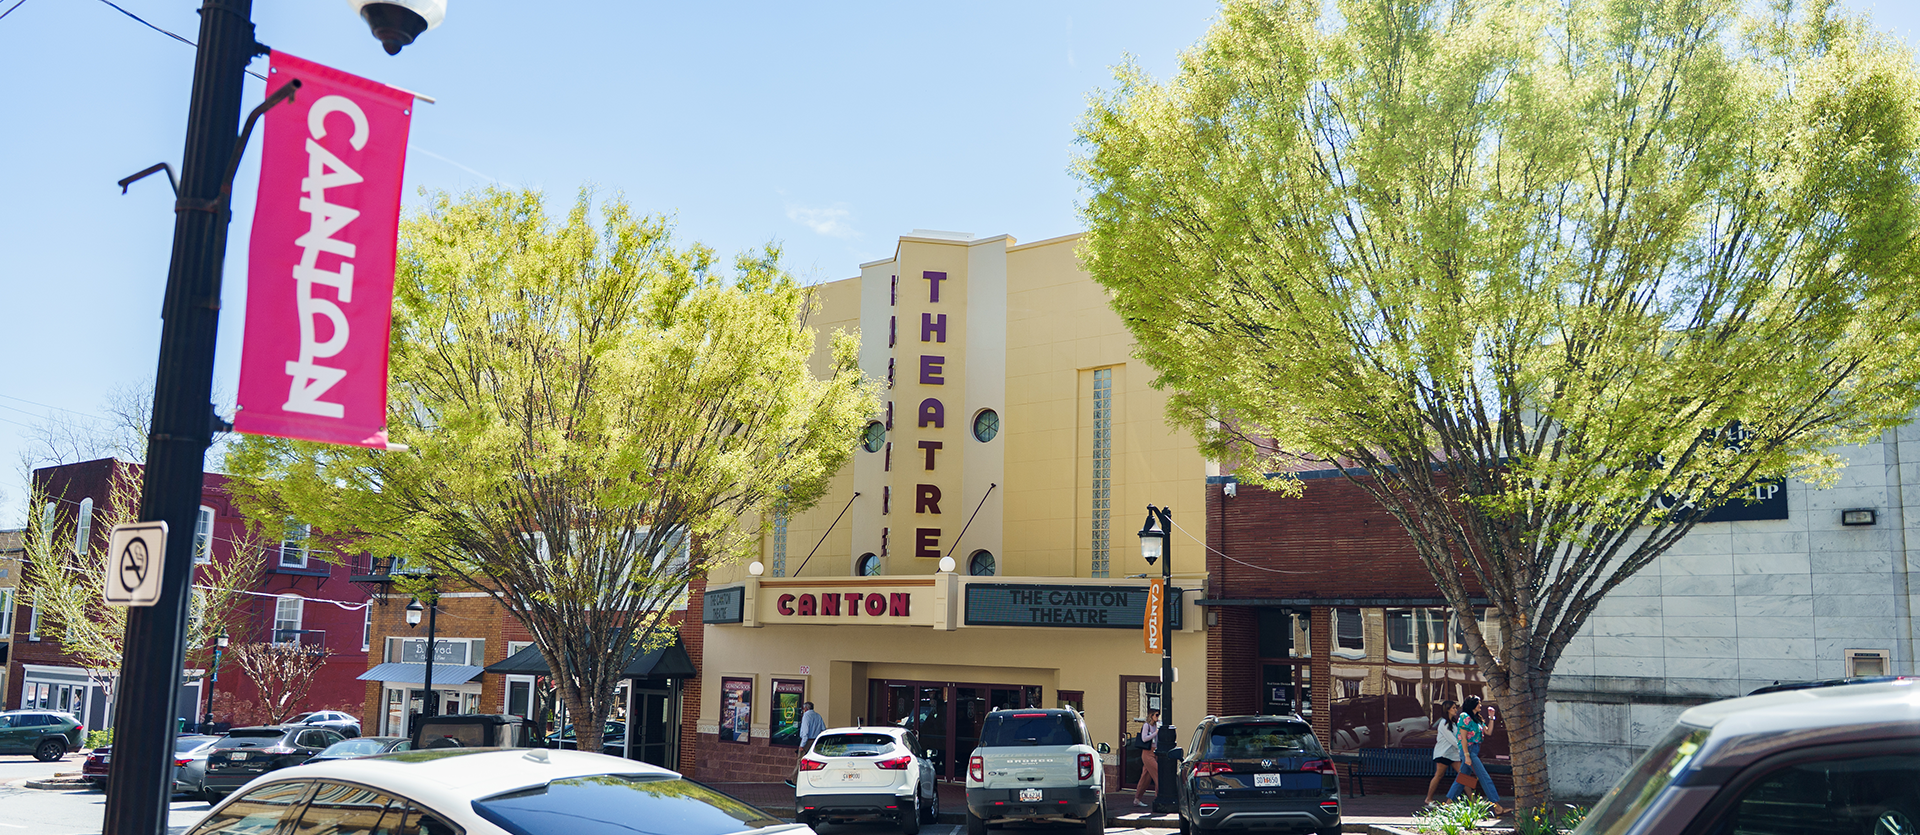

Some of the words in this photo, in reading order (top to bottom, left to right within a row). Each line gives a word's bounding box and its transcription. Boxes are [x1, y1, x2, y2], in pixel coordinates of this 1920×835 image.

[282, 95, 369, 419] CANTON
[915, 271, 947, 557] THEATRE
[1744, 484, 1780, 500] LLP
[777, 593, 911, 616] CANTON
[1010, 590, 1043, 605] THE
[1048, 591, 1128, 607] CANTON
[1029, 607, 1108, 624] THEATRE
[1148, 584, 1160, 649] CANTON
